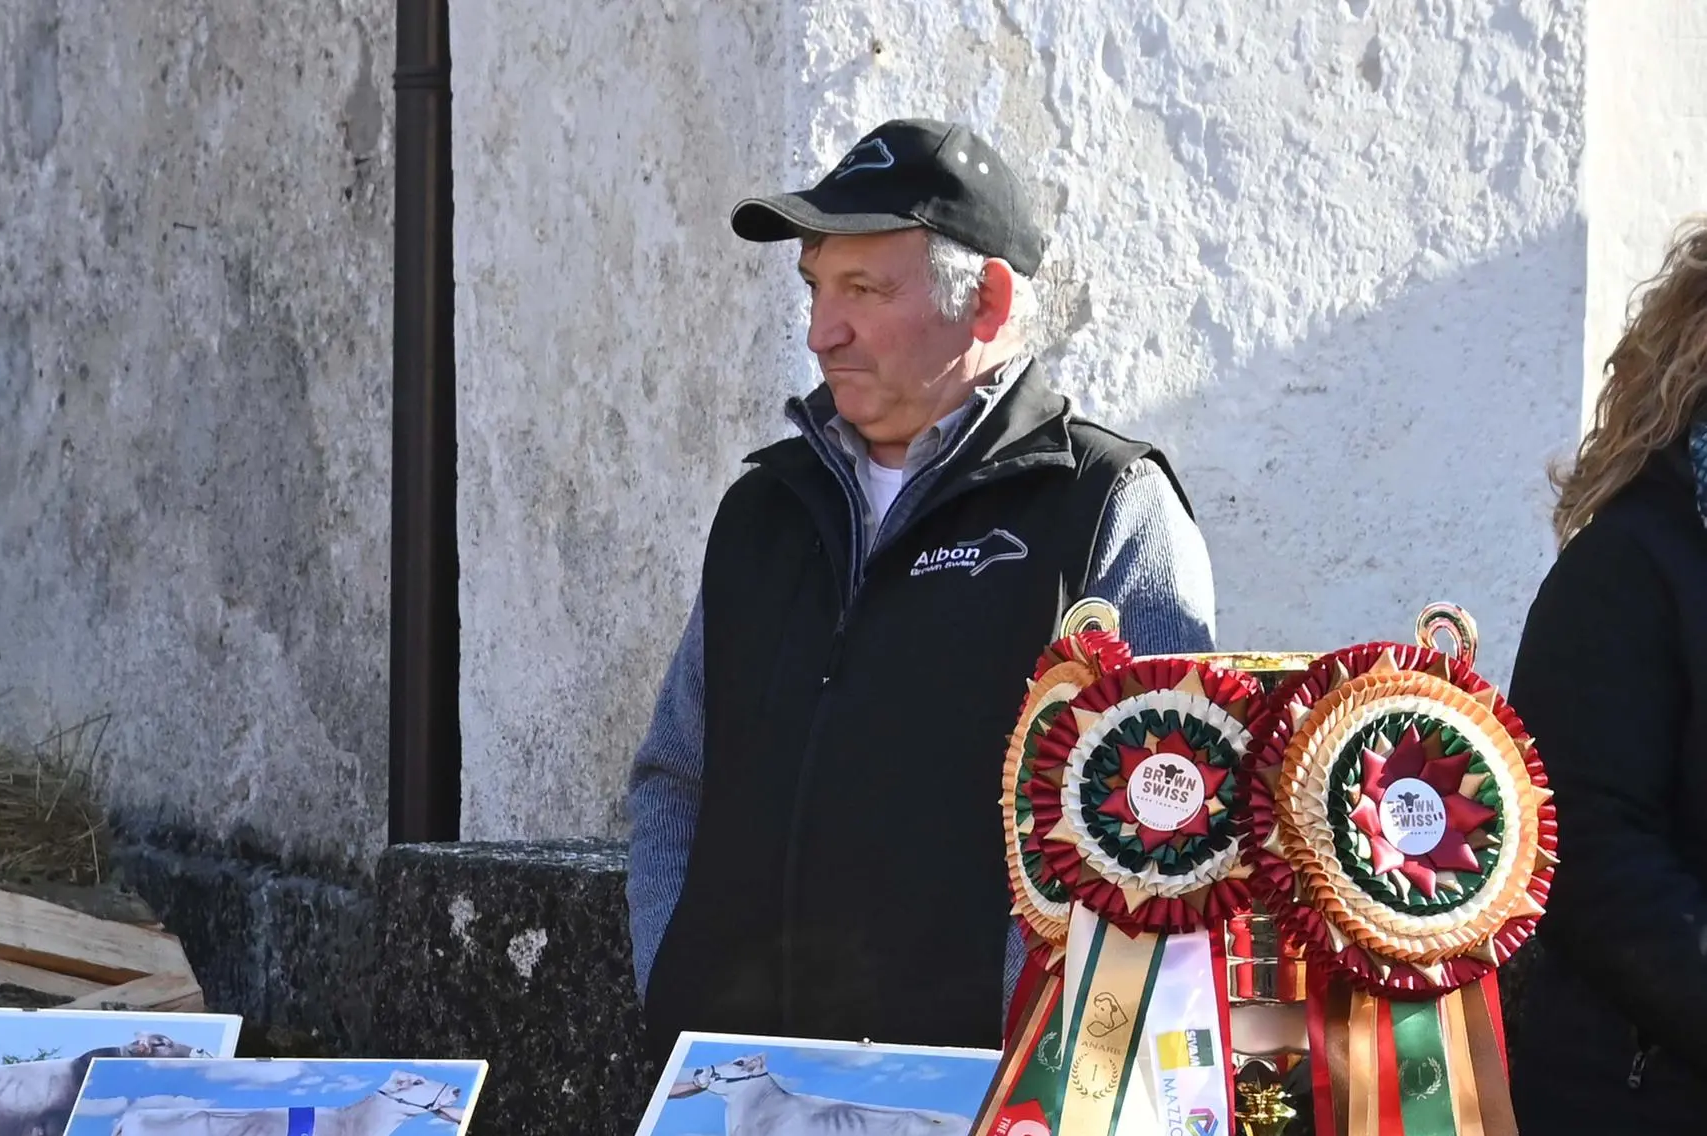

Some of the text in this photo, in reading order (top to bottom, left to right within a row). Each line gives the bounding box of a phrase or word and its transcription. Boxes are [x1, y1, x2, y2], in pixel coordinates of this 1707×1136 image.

[914, 547, 980, 567] Albon
[1142, 782, 1189, 803] SWISS
[997, 1116, 1012, 1135] THE
